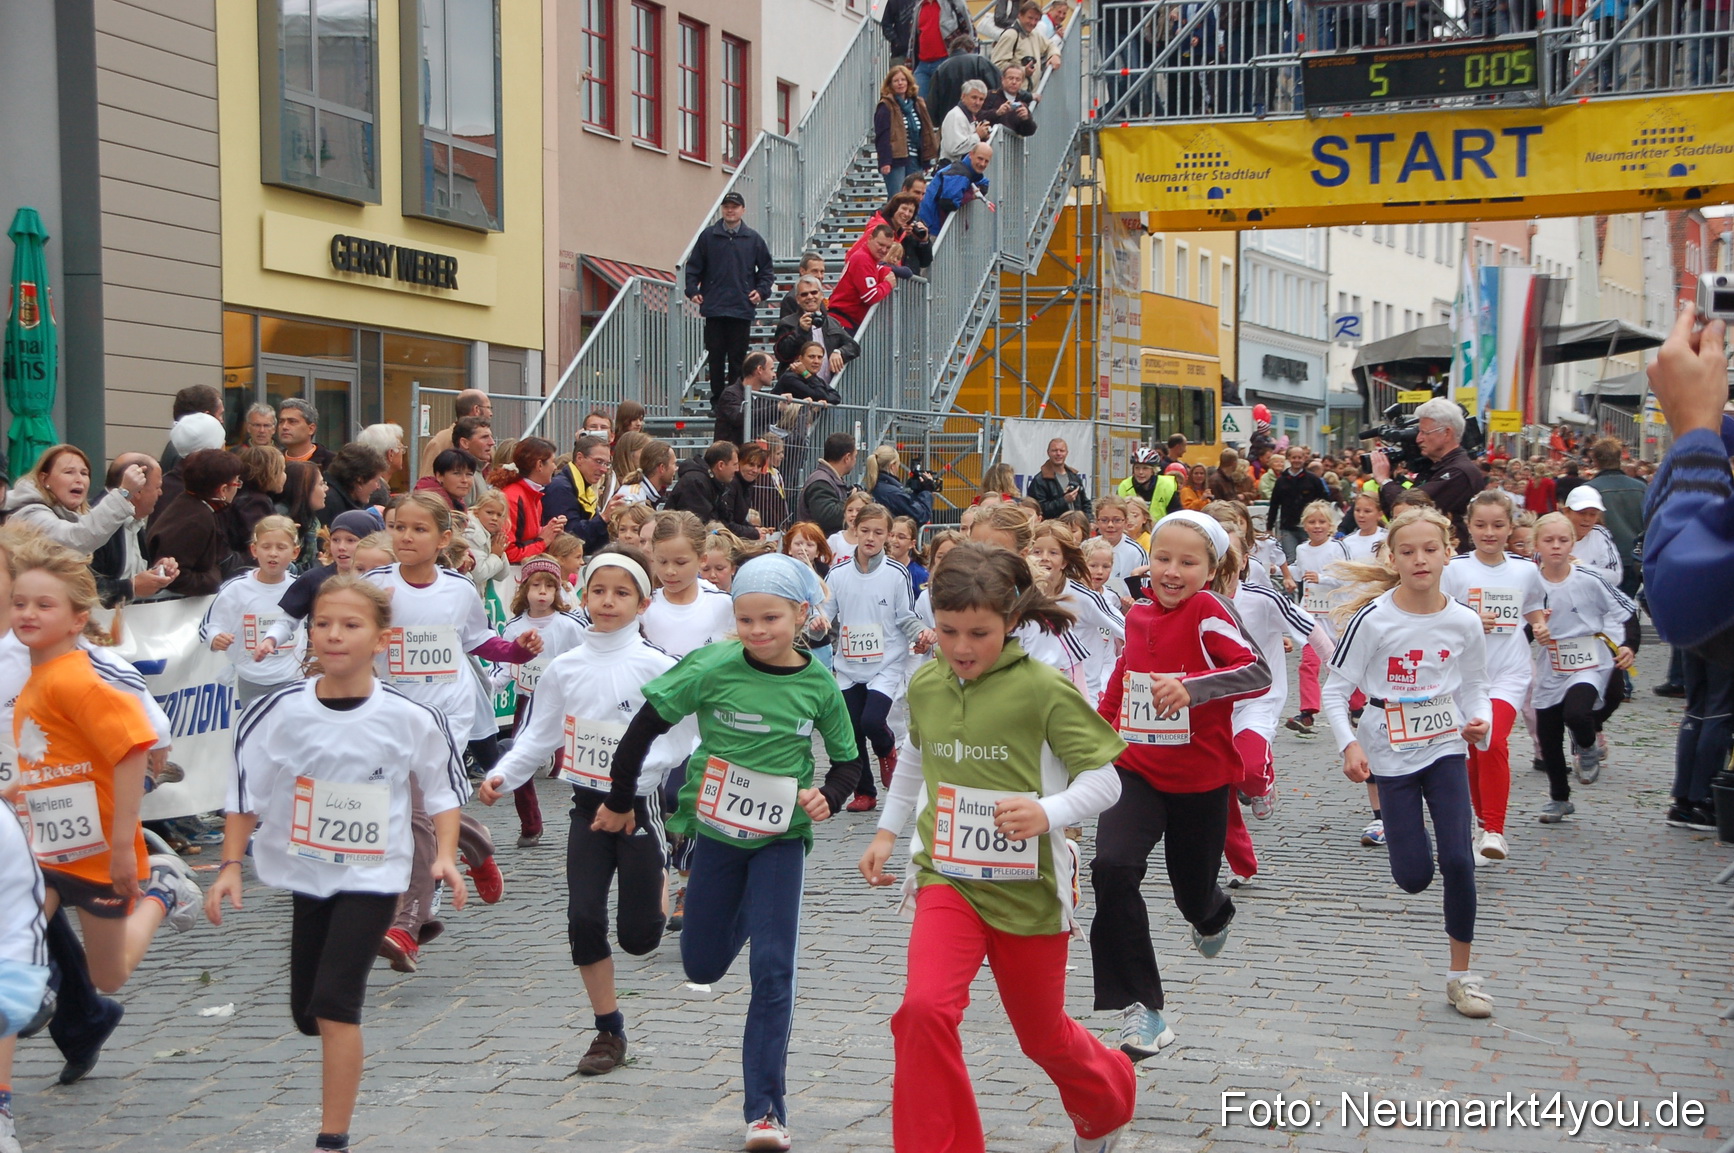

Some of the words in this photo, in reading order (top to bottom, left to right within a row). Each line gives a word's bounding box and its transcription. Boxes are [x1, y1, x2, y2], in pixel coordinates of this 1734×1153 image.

[1369, 63, 1389, 96] 5
[1311, 125, 1544, 187] START
[1583, 148, 1670, 163] Neumarkter
[1135, 171, 1208, 183] Neumarkter
[1211, 168, 1272, 181] Stadtlauf
[331, 234, 396, 278] GERRY
[396, 246, 459, 291] WEBER
[1335, 315, 1361, 338] R
[1484, 591, 1513, 601] Theresa
[406, 631, 438, 645] Sophie
[851, 639, 880, 652] 7191
[407, 648, 452, 666] 7000
[1560, 652, 1593, 666] 7054
[1389, 674, 1415, 684] DKMS
[1410, 711, 1453, 733] 7209
[1156, 733, 1188, 741] PFLEIDERER
[577, 745, 615, 769] 719
[929, 742, 954, 758] URO
[964, 746, 1009, 760] POLES
[42, 761, 94, 781] Reisen
[730, 770, 750, 789] Lea
[704, 784, 718, 797] B3
[28, 796, 74, 813] Marlene
[326, 792, 362, 811] Luisa
[726, 792, 784, 825] 7018
[36, 815, 93, 844] 7033
[318, 816, 380, 844] 7208
[937, 819, 950, 833] B3
[345, 853, 385, 862] PFLEIDERER
[993, 867, 1036, 876] PFLEIDERER
